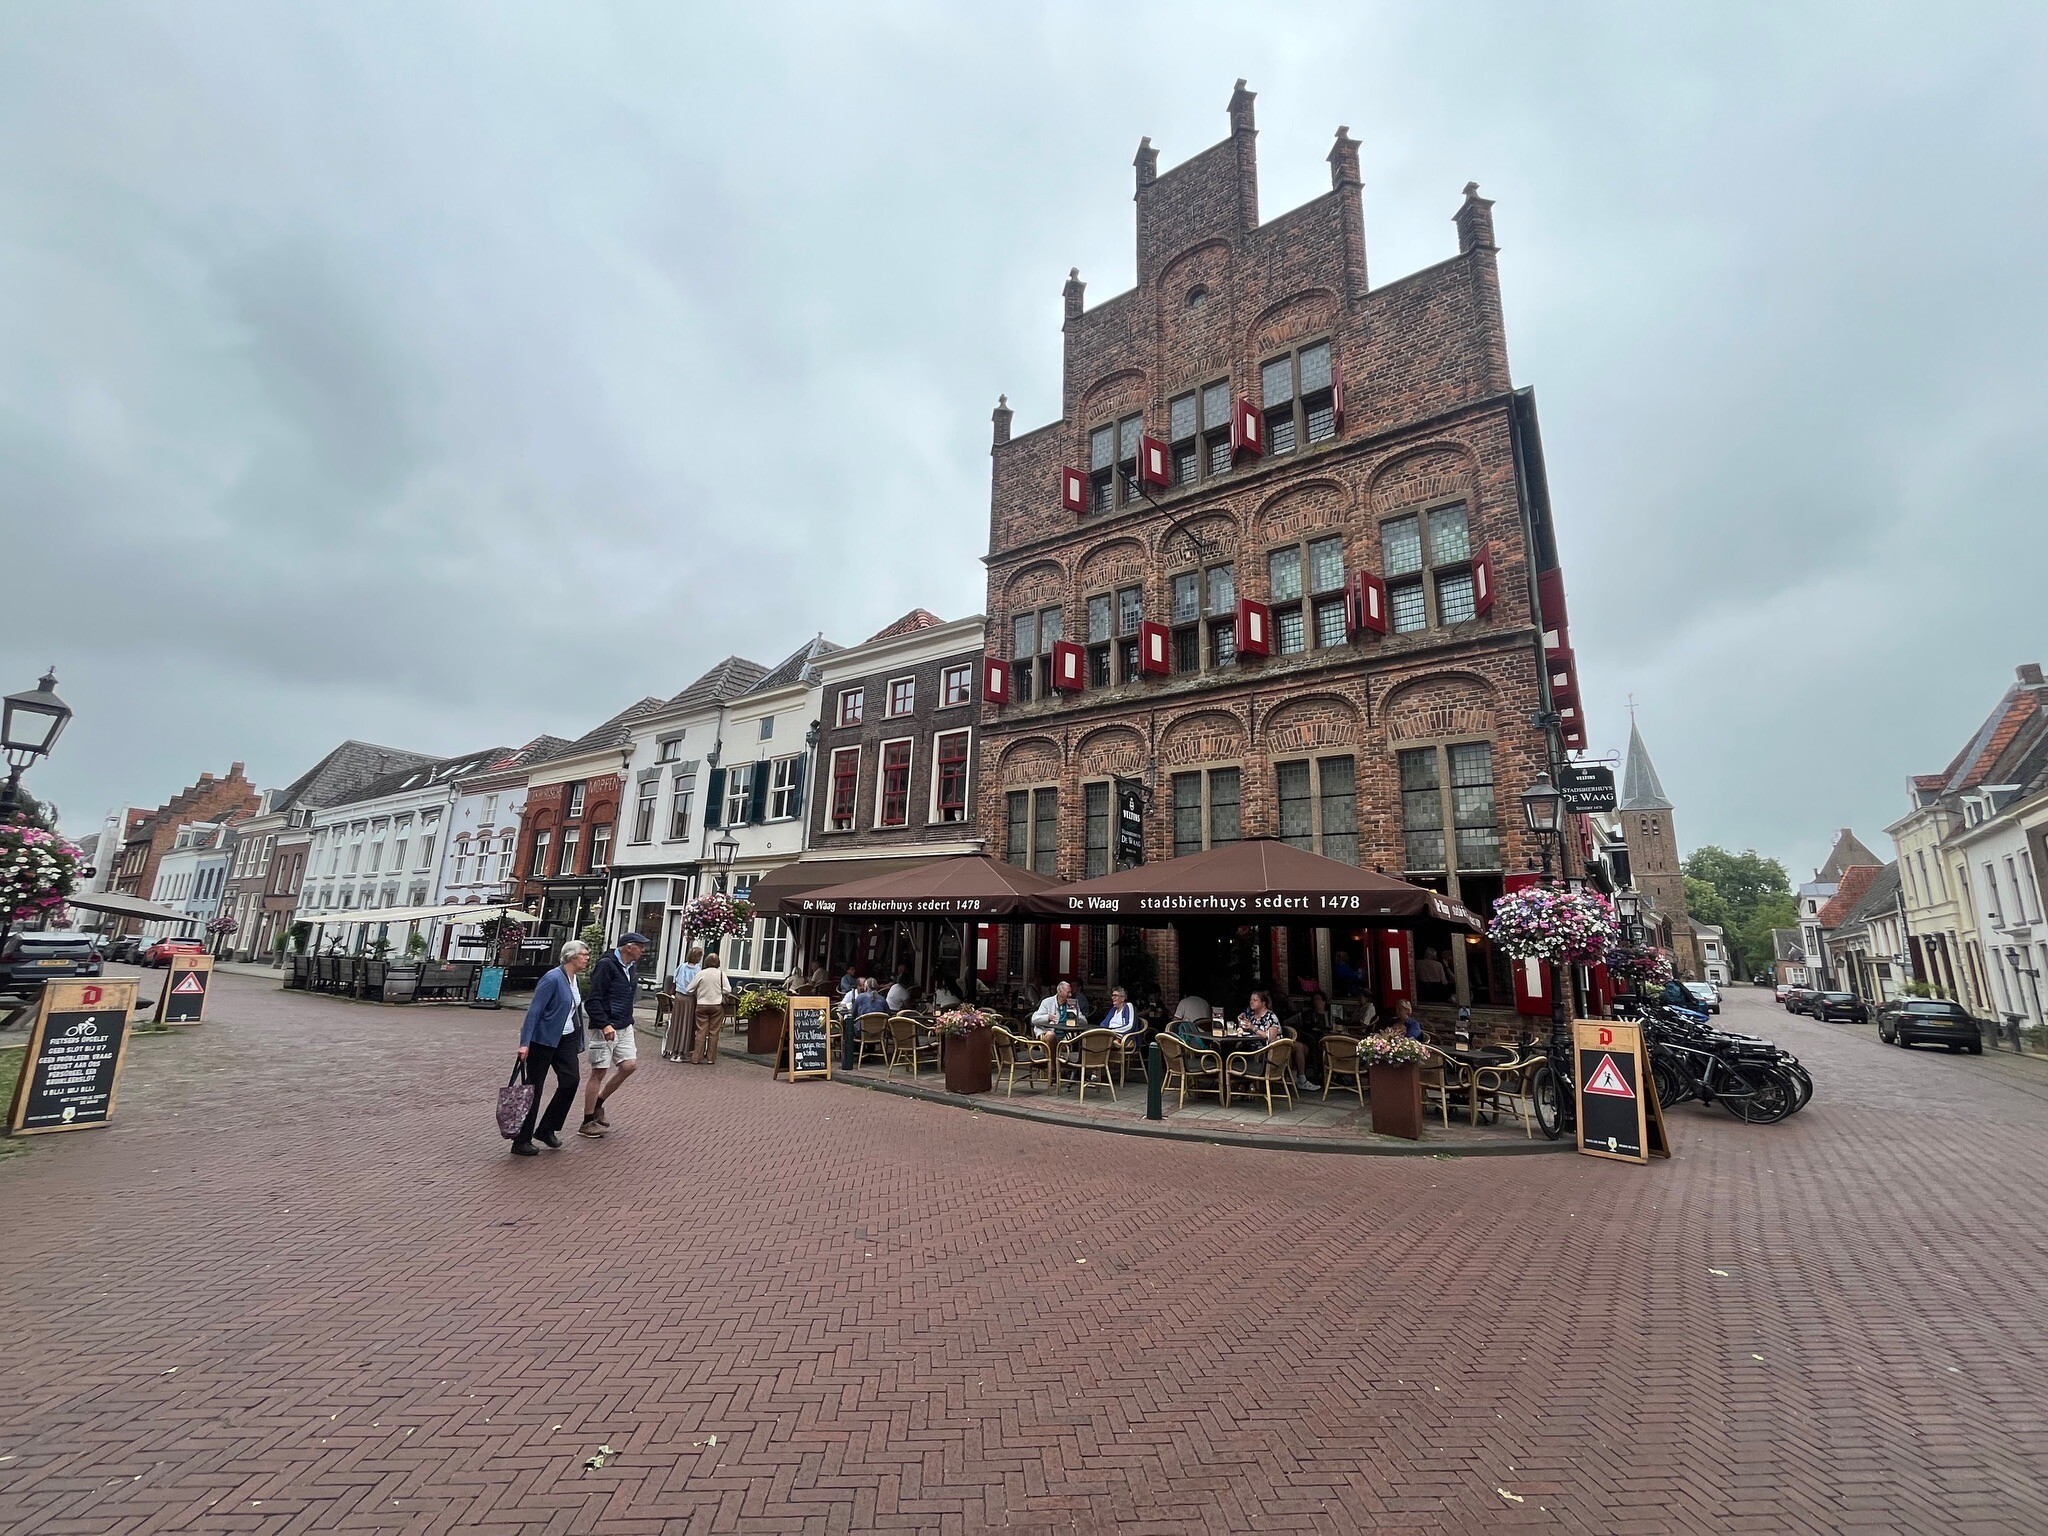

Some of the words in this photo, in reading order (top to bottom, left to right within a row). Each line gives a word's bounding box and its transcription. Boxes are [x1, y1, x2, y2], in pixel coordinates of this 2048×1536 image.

[1580, 793, 1614, 801] WAAG
[803, 900, 813, 909] De
[816, 900, 836, 912] Waag
[849, 900, 913, 912] stadsbierhuys
[917, 900, 950, 910] sedert
[956, 900, 980, 910] 1478
[1068, 897, 1083, 909] De
[1088, 897, 1119, 912] Waag
[1140, 895, 1247, 911] stadsbierhuys
[1255, 895, 1309, 908] sedert
[1320, 896, 1360, 908] 1478
[1598, 1028, 1613, 1045] D
